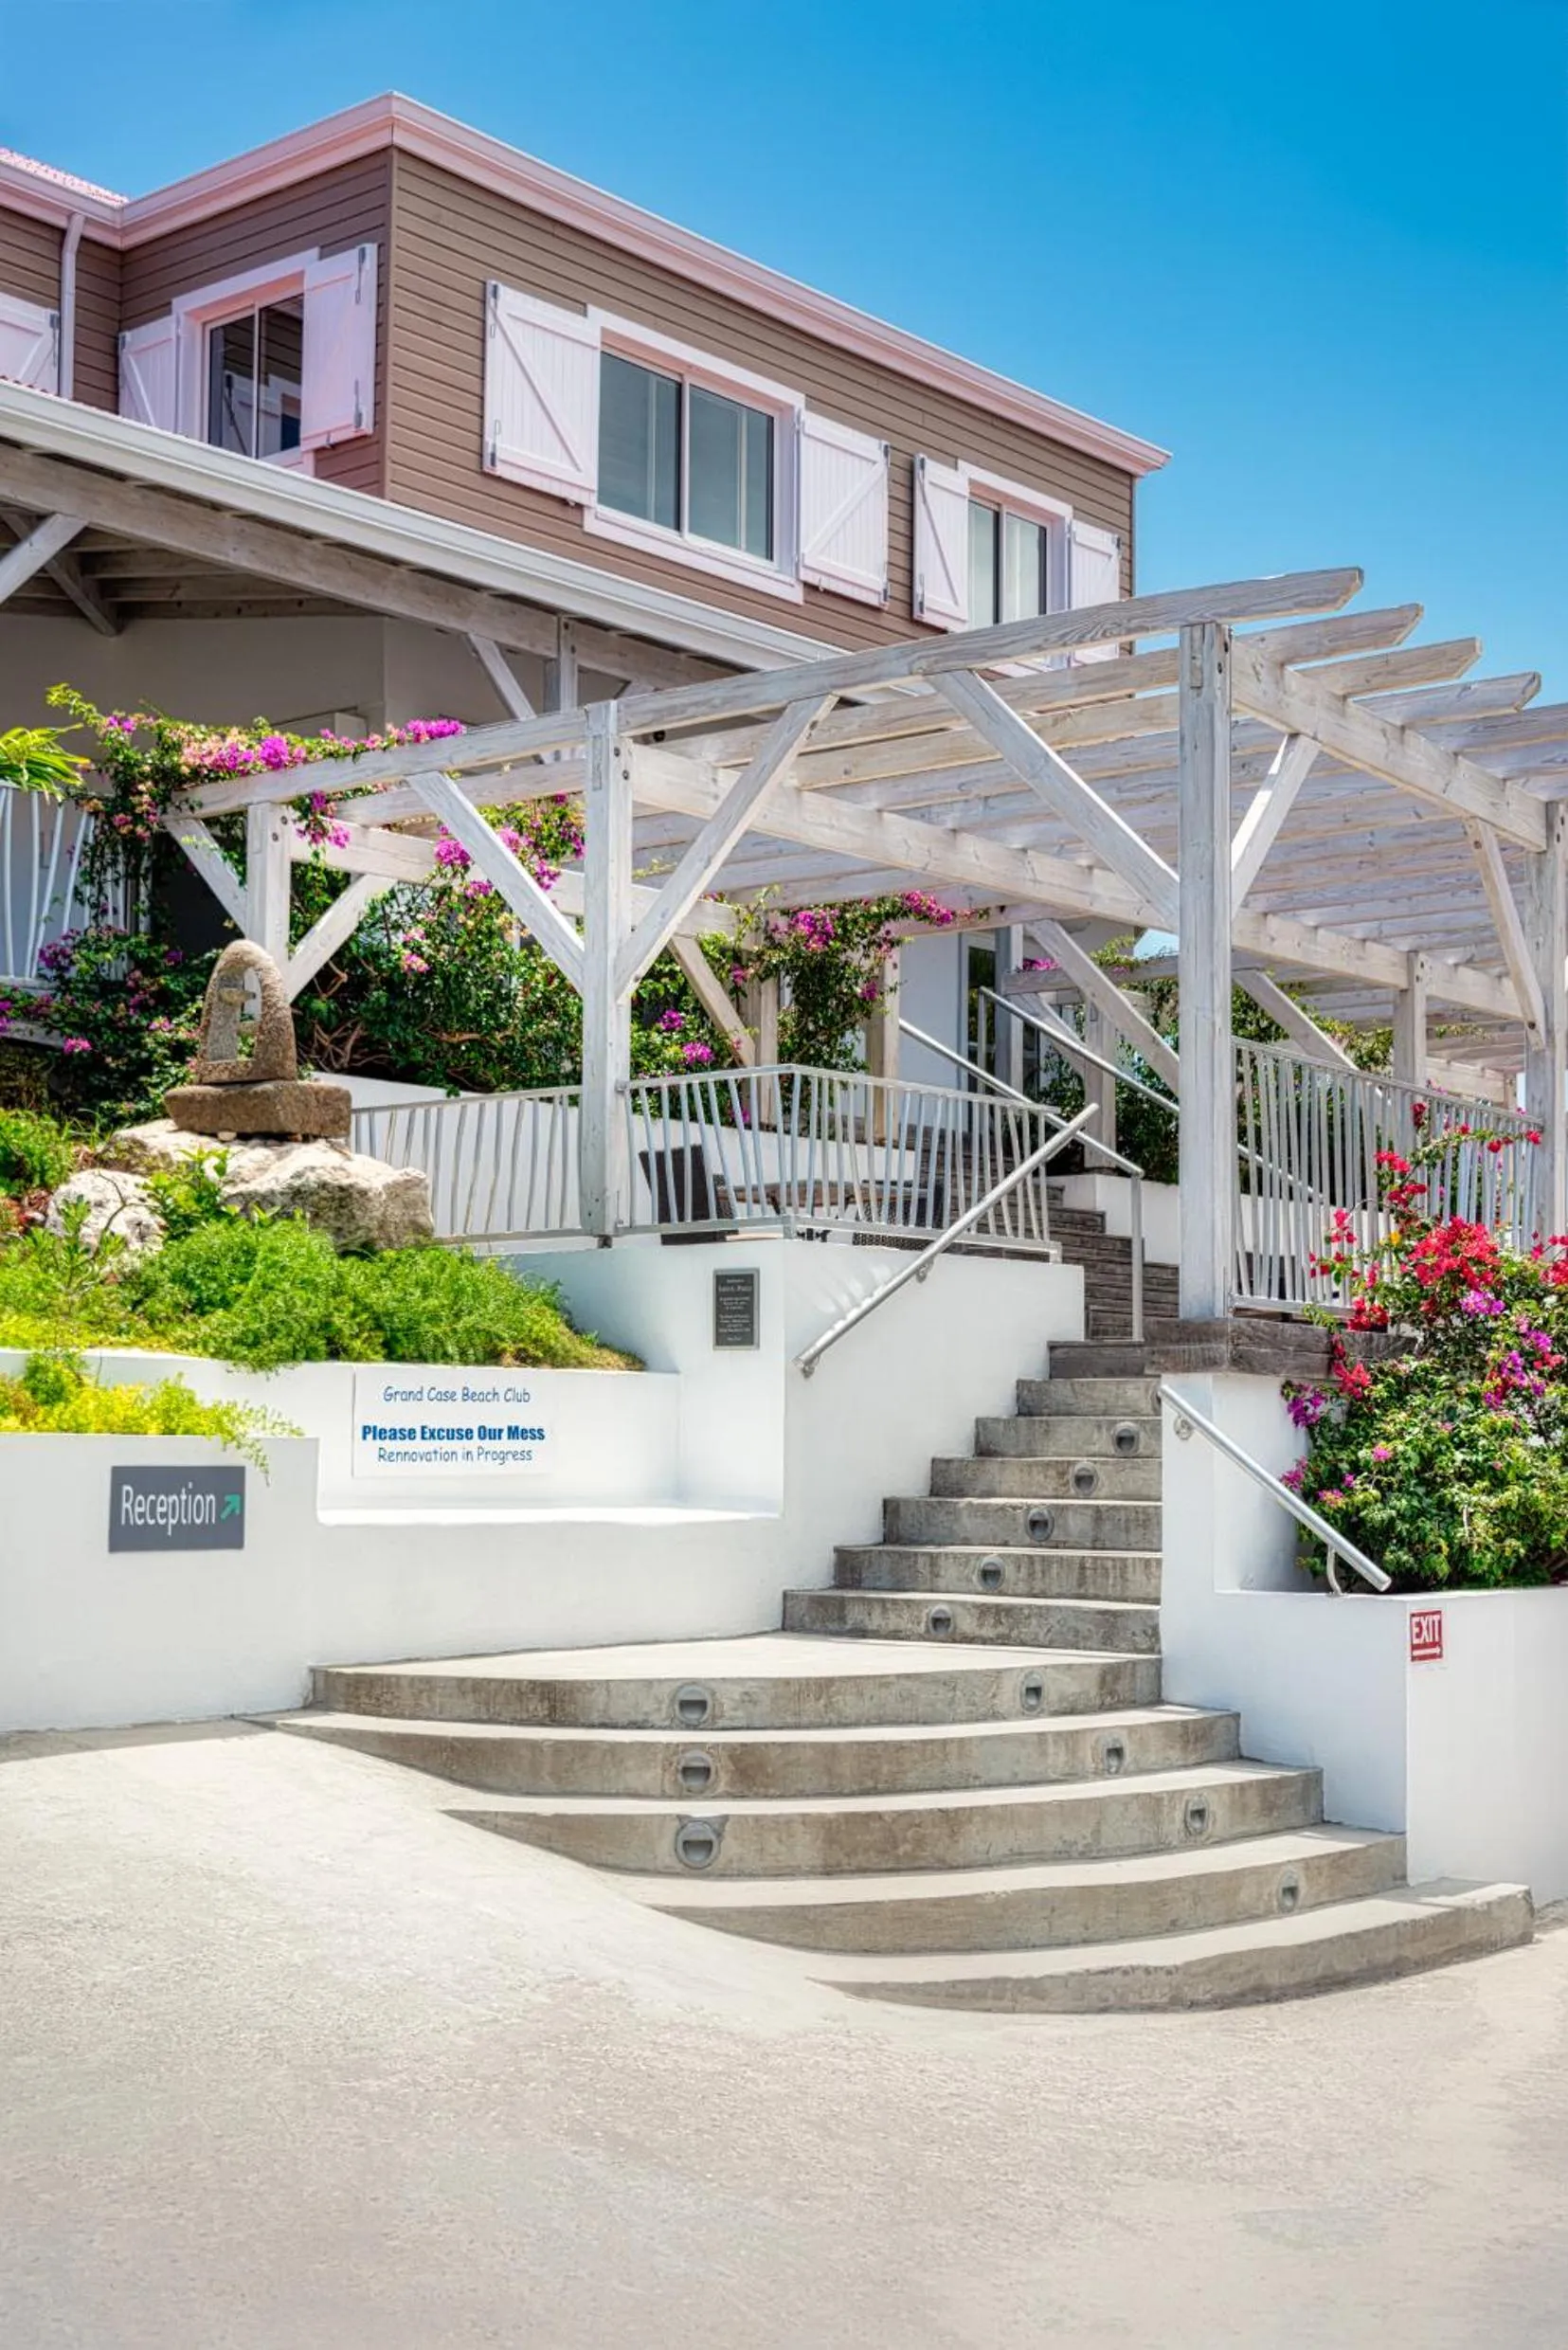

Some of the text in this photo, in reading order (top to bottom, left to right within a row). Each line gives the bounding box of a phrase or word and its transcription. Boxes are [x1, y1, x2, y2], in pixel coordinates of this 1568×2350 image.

[383, 1385, 531, 1403] Grand Case Beach Club
[362, 1425, 546, 1440] Please Excuse Our Mess
[377, 1446, 532, 1465] Rennovation in Progress
[120, 1481, 216, 1537] Reception
[1412, 1614, 1440, 1644] EXIT
